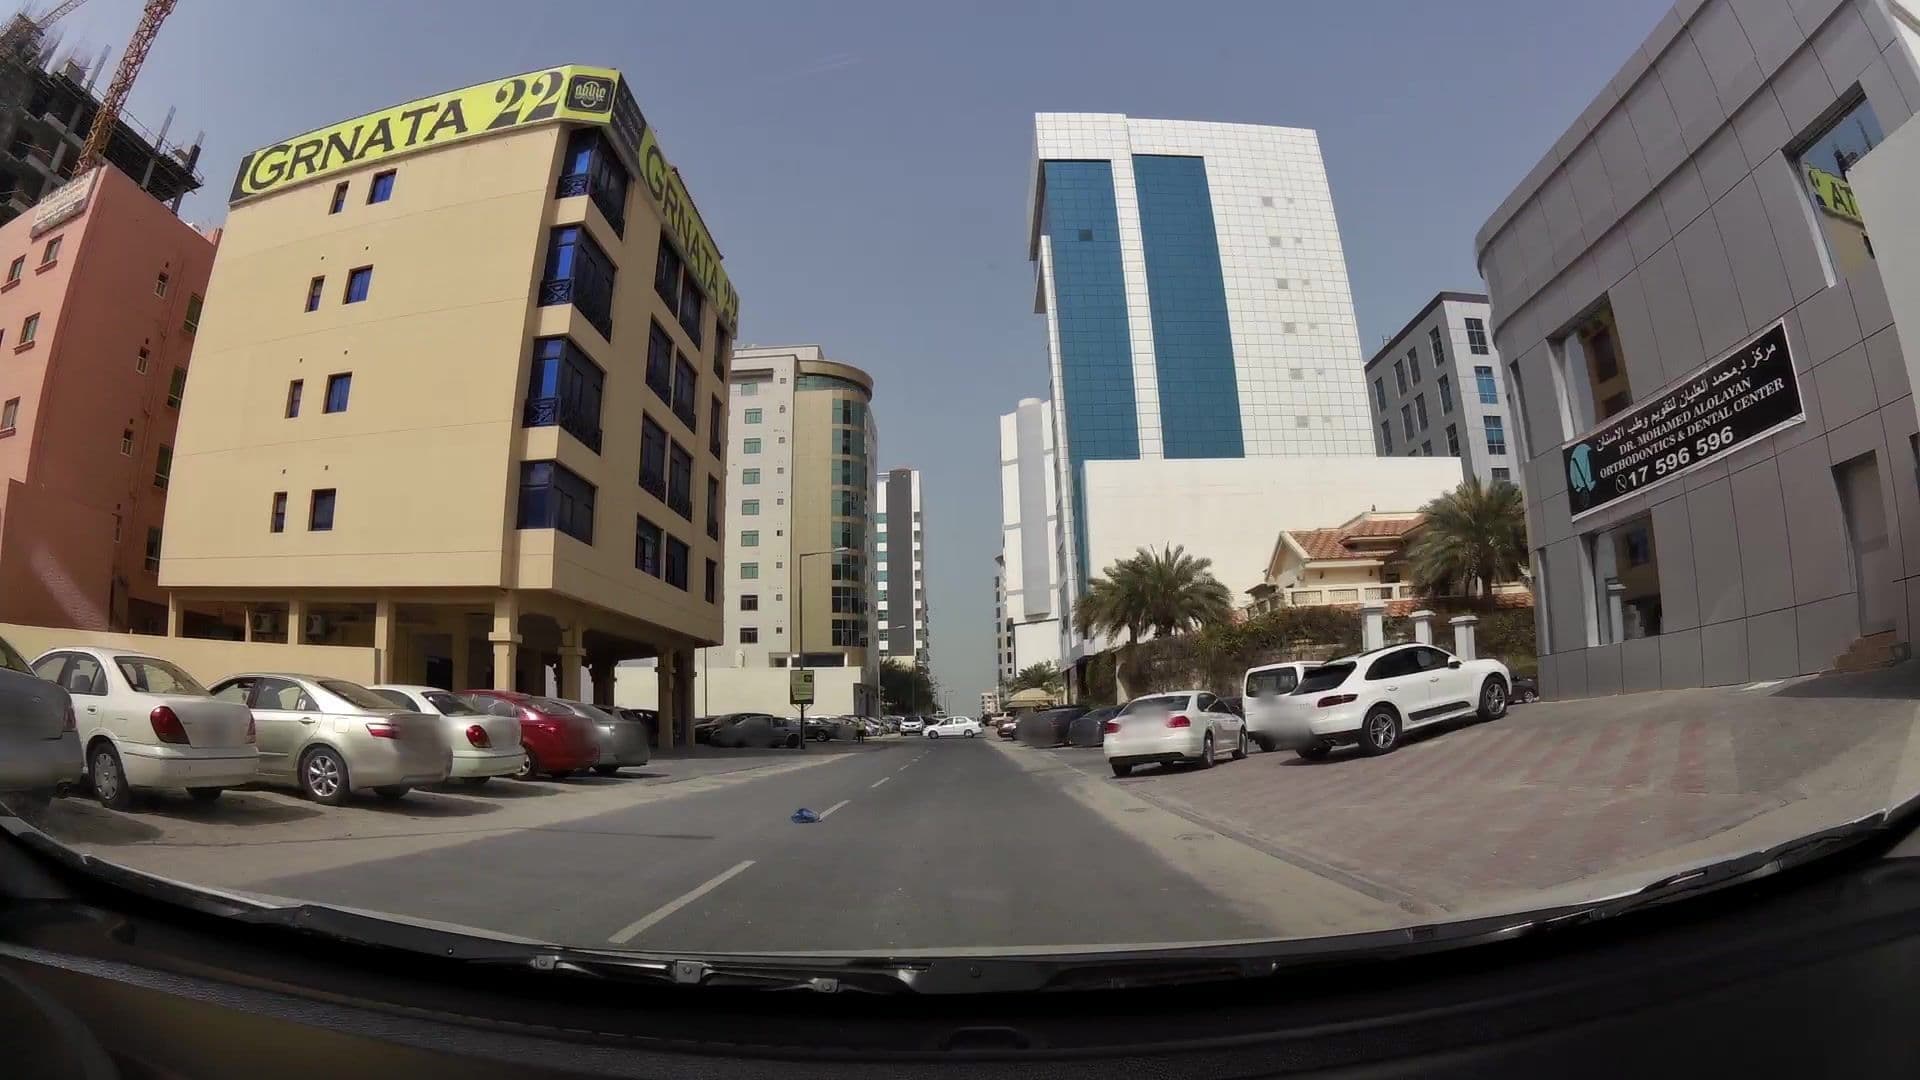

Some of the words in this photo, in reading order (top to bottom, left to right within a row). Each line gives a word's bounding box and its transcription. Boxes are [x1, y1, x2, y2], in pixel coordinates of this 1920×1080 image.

[249, 98, 468, 190] GRNATA
[486, 71, 564, 131] 22
[646, 144, 719, 308] GRNATA
[1750, 343, 1777, 368] مركز
[1619, 440, 1637, 456] DR.
[1638, 410, 1692, 445] MOHAMED
[1693, 376, 1752, 416] ALOLAYAN
[1650, 396, 1677, 426] لتقويم
[1679, 378, 1709, 409] العليان
[1600, 434, 1677, 479] ORTHODONTICS
[1677, 430, 1686, 442] &
[1687, 406, 1733, 437] DENTAL
[1733, 377, 1785, 412] CENTER
[1627, 416, 1649, 434] وطب
[1628, 465, 1649, 487] 17
[1655, 447, 1690, 475] 596
[1696, 425, 1734, 457] 596
